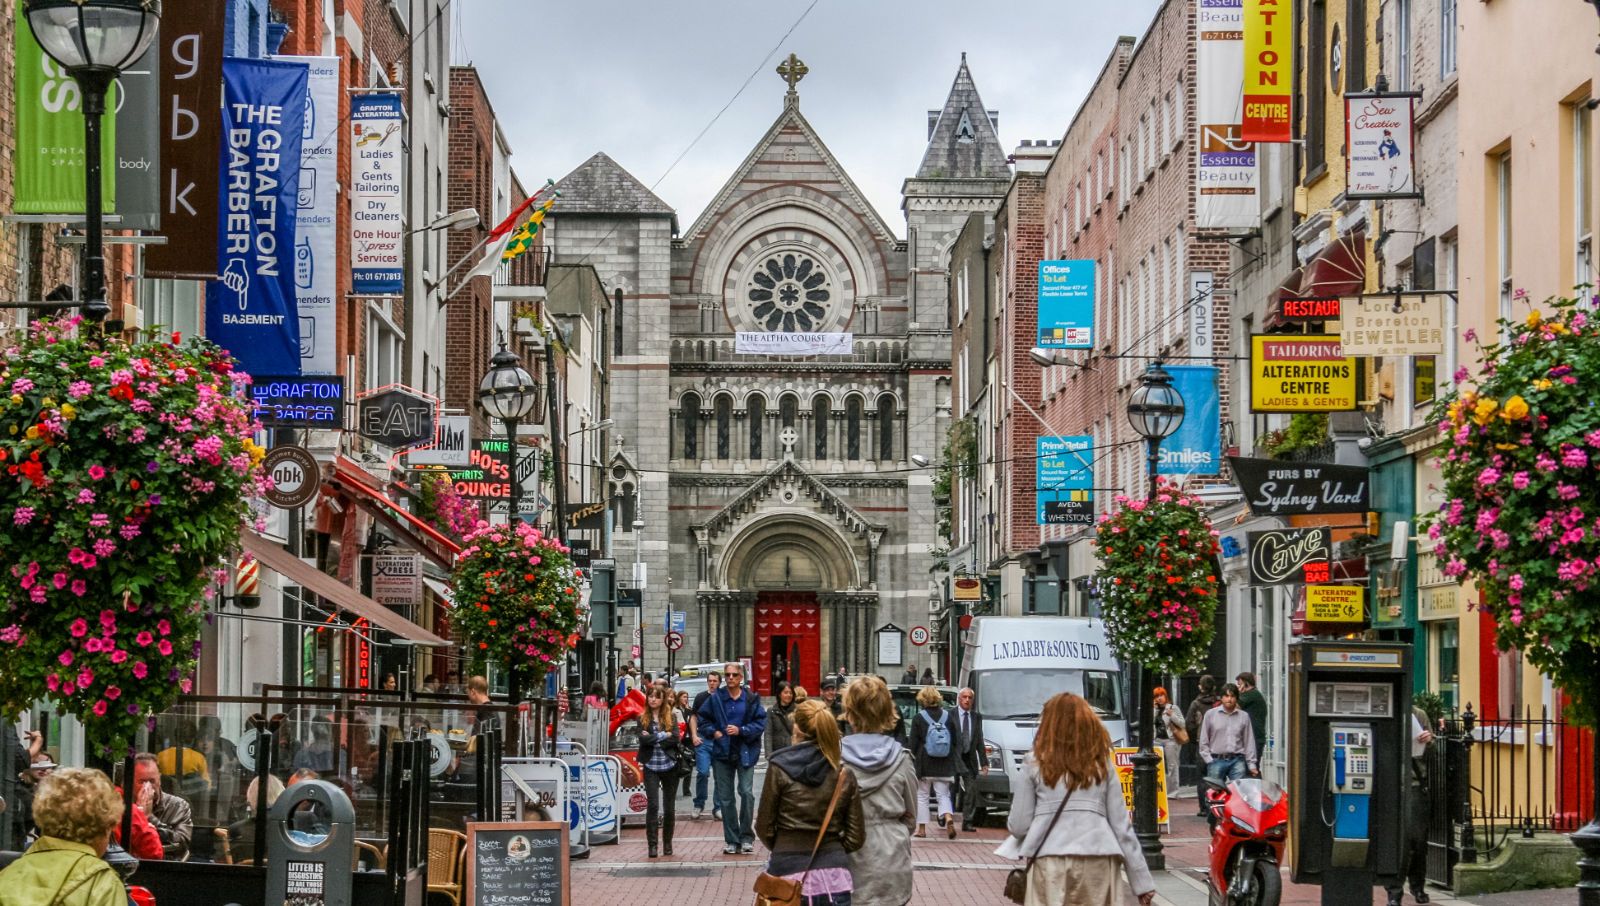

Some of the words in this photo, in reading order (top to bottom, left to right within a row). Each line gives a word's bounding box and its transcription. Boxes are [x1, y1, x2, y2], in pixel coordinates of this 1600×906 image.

[1201, 11, 1240, 22] Beau
[309, 67, 334, 75] nders
[1246, 103, 1288, 118] CENTRE
[1364, 98, 1396, 116] Sew
[232, 103, 283, 125] THE
[168, 34, 200, 217] gbk
[1355, 115, 1401, 129] Creative
[302, 147, 333, 155] enders
[360, 150, 394, 159] Ladies
[119, 157, 151, 172] body
[373, 161, 381, 170] &
[1201, 154, 1255, 166] Essence
[361, 172, 393, 181] Gents
[1200, 170, 1253, 184] Beauty
[226, 128, 252, 255] BARBER
[354, 183, 400, 194] Tailoring
[255, 128, 283, 277] GRAFTON
[368, 200, 387, 212] Dry
[354, 211, 400, 221] Cleaners
[353, 229, 374, 239] One
[376, 229, 401, 239] Hour
[358, 240, 396, 252] Xpress
[357, 253, 398, 262] Services
[1042, 265, 1071, 274] Offices
[353, 273, 365, 281] Ph:
[365, 272, 373, 281] 01
[374, 272, 401, 281] 6717813
[1043, 275, 1053, 283] To
[1053, 275, 1067, 283] Let
[1284, 301, 1339, 316] RESTAUR
[1363, 302, 1421, 312] Loran
[222, 314, 285, 325] BASEMENT
[1355, 316, 1430, 328] Brereton
[741, 333, 759, 342] THE
[761, 333, 790, 342] ALPHA
[791, 333, 826, 343] COURSE
[1342, 328, 1442, 346] JEWELLER
[1262, 365, 1350, 379] ALTERATIONS
[269, 382, 340, 399] GRAFTON
[1281, 381, 1330, 395] CENTRE
[1262, 397, 1298, 406] LADIES
[1302, 398, 1309, 406] &
[1313, 397, 1349, 406] GENTS
[364, 403, 429, 437] EAT
[481, 441, 509, 452] WINE
[1041, 442, 1064, 450] Prime
[1066, 441, 1088, 449] Retail
[1041, 451, 1058, 459] Unit
[1157, 447, 1212, 463] Smiles
[470, 449, 510, 480] HOES
[274, 467, 302, 485] gbk
[1268, 470, 1300, 480] FURS
[1304, 469, 1321, 478] BY
[455, 482, 511, 498] OUNGE
[1252, 481, 1318, 512] Sydney
[1321, 481, 1365, 504] Vard
[1047, 514, 1092, 523] WHETSTONE
[1252, 529, 1327, 583] Cave
[1303, 563, 1329, 571] WINE
[1305, 571, 1329, 582] BAR
[914, 631, 924, 640] 50
[1079, 642, 1100, 661] LTD
[288, 862, 314, 872] LITTER
[314, 863, 324, 873] IS
[288, 872, 324, 880] DISGUSTING
